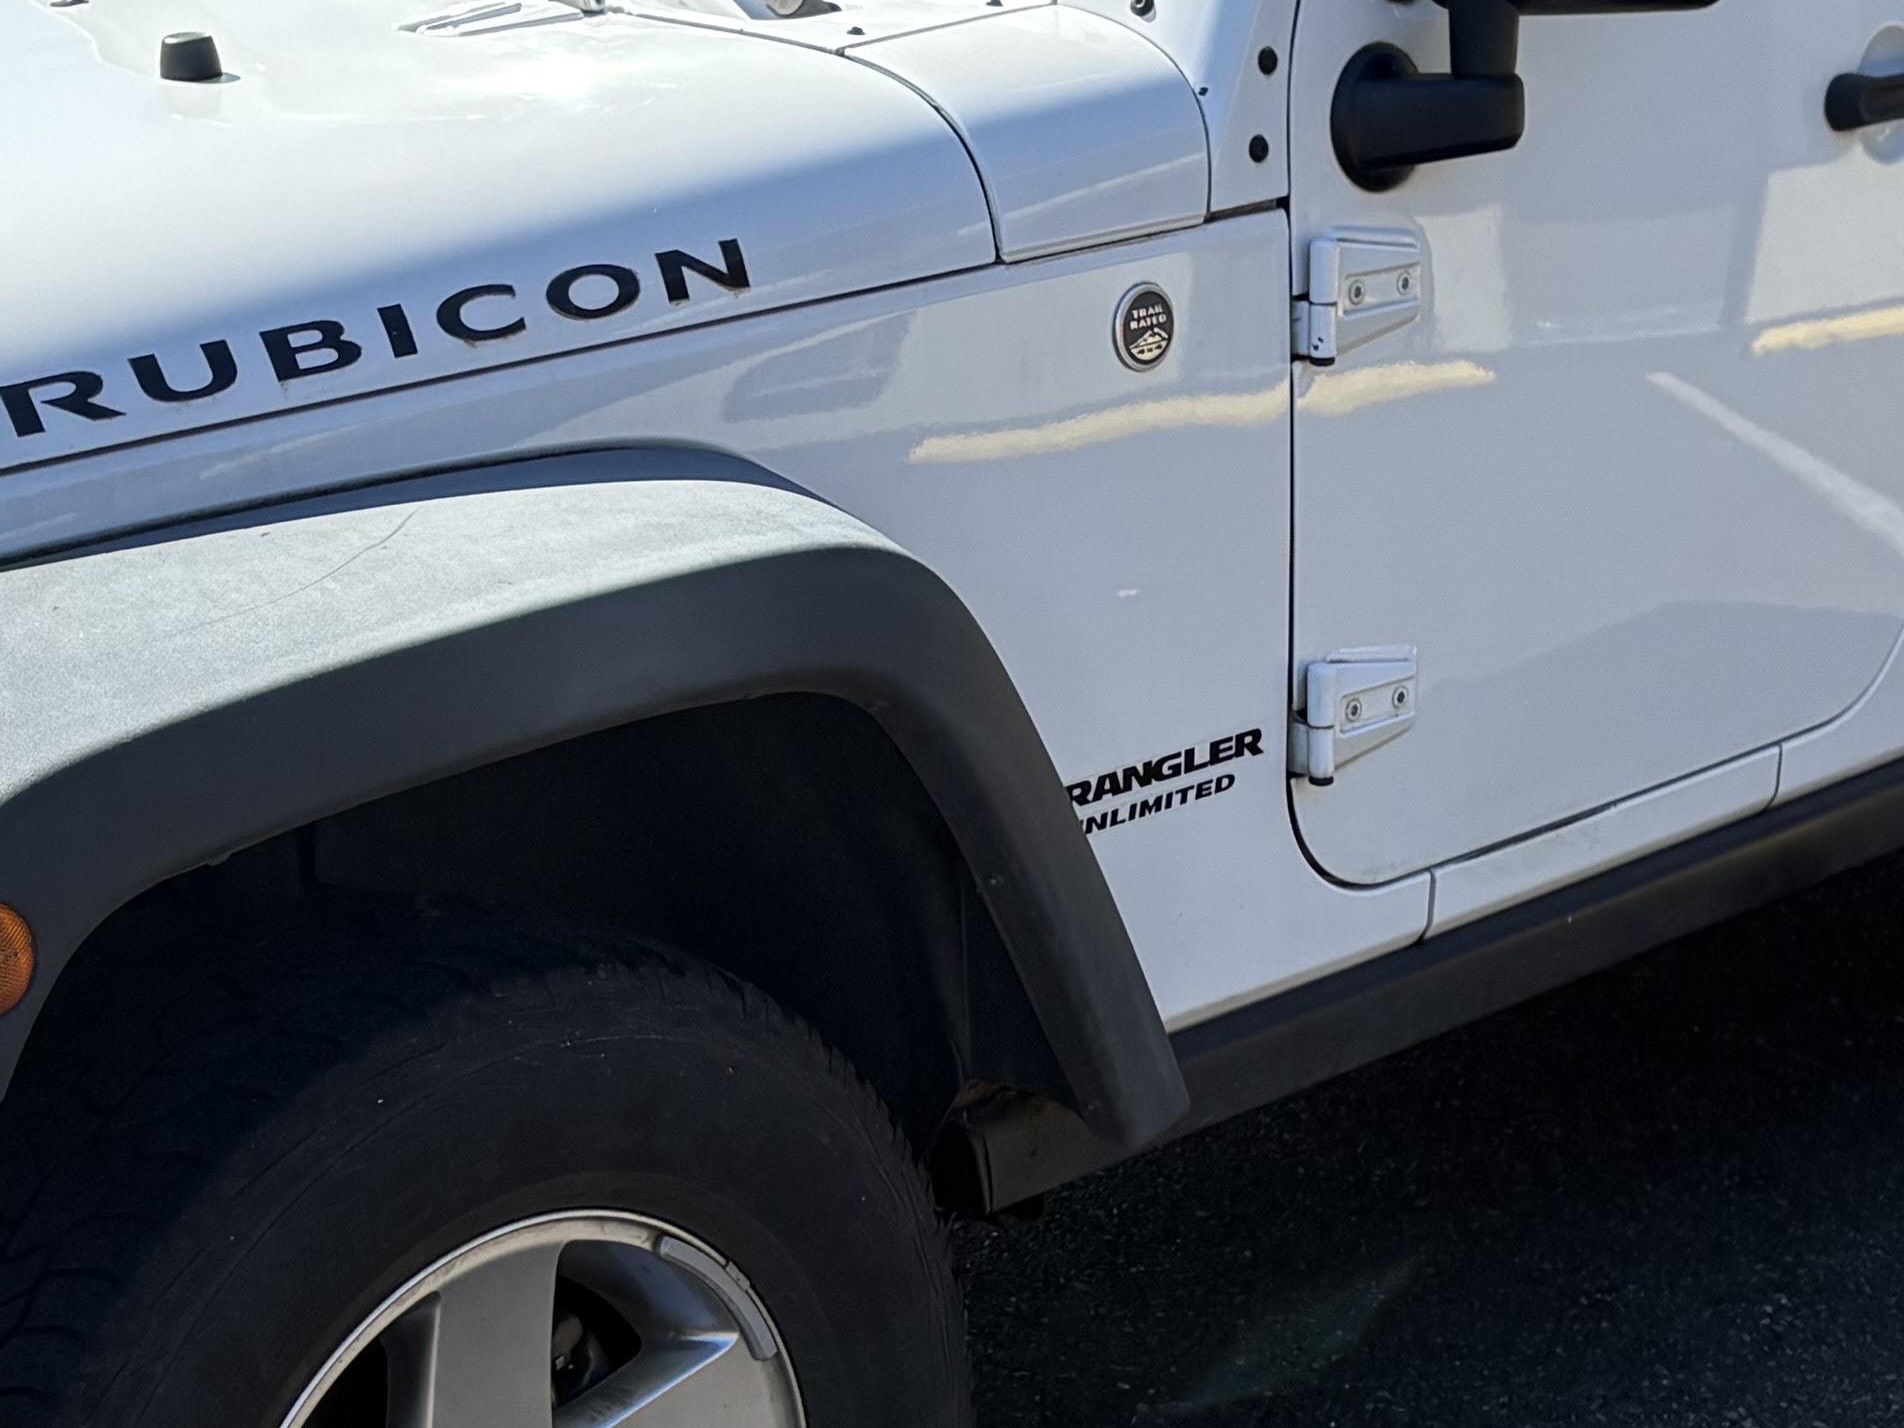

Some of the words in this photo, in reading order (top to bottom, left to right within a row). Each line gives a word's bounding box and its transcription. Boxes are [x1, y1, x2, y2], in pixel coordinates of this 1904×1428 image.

[1129, 314, 1167, 330] RATED
[1131, 304, 1163, 319] TRAIL
[1064, 728, 1264, 806] RANGLER
[1080, 774, 1235, 834] NLIMITED
